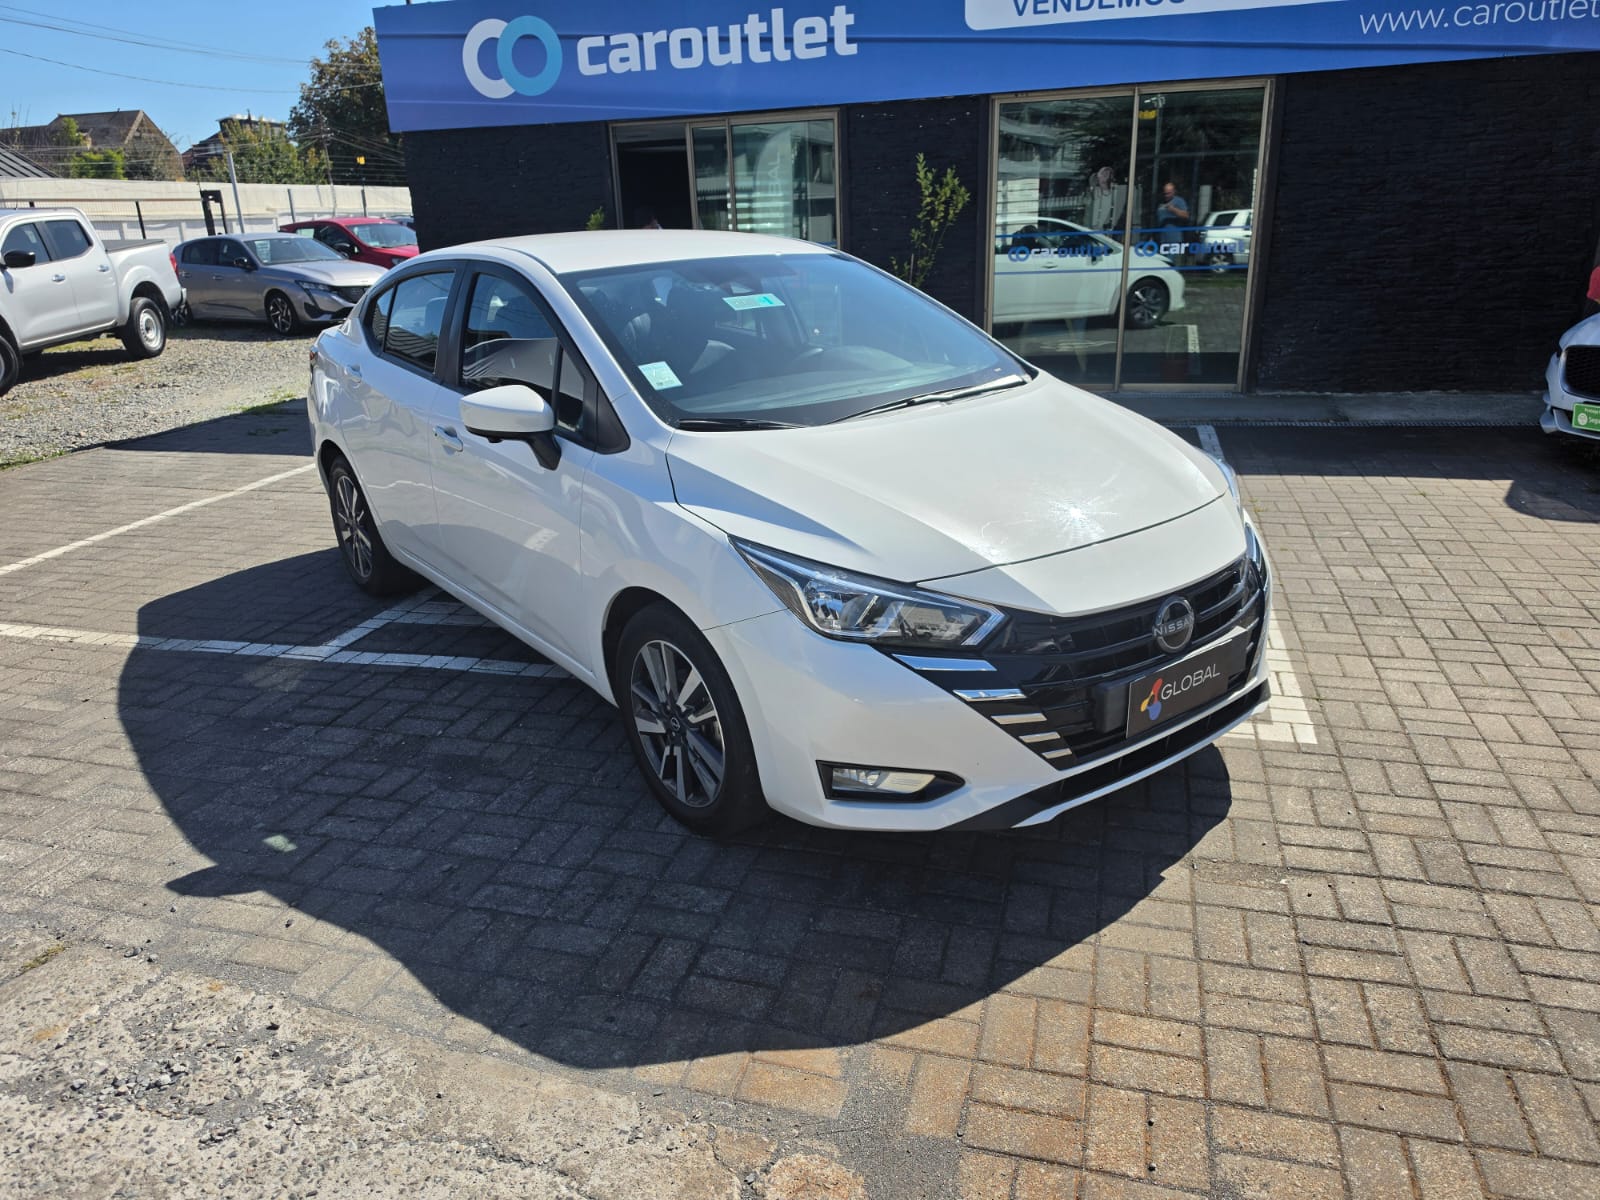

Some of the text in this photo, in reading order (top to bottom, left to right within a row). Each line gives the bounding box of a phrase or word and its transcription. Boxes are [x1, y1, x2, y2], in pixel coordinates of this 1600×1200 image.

[577, 5, 858, 76] caroutlet
[1031, 243, 1110, 258] caroutlet
[1153, 613, 1194, 637] NISSAN
[1161, 663, 1221, 700] GLOBAL
